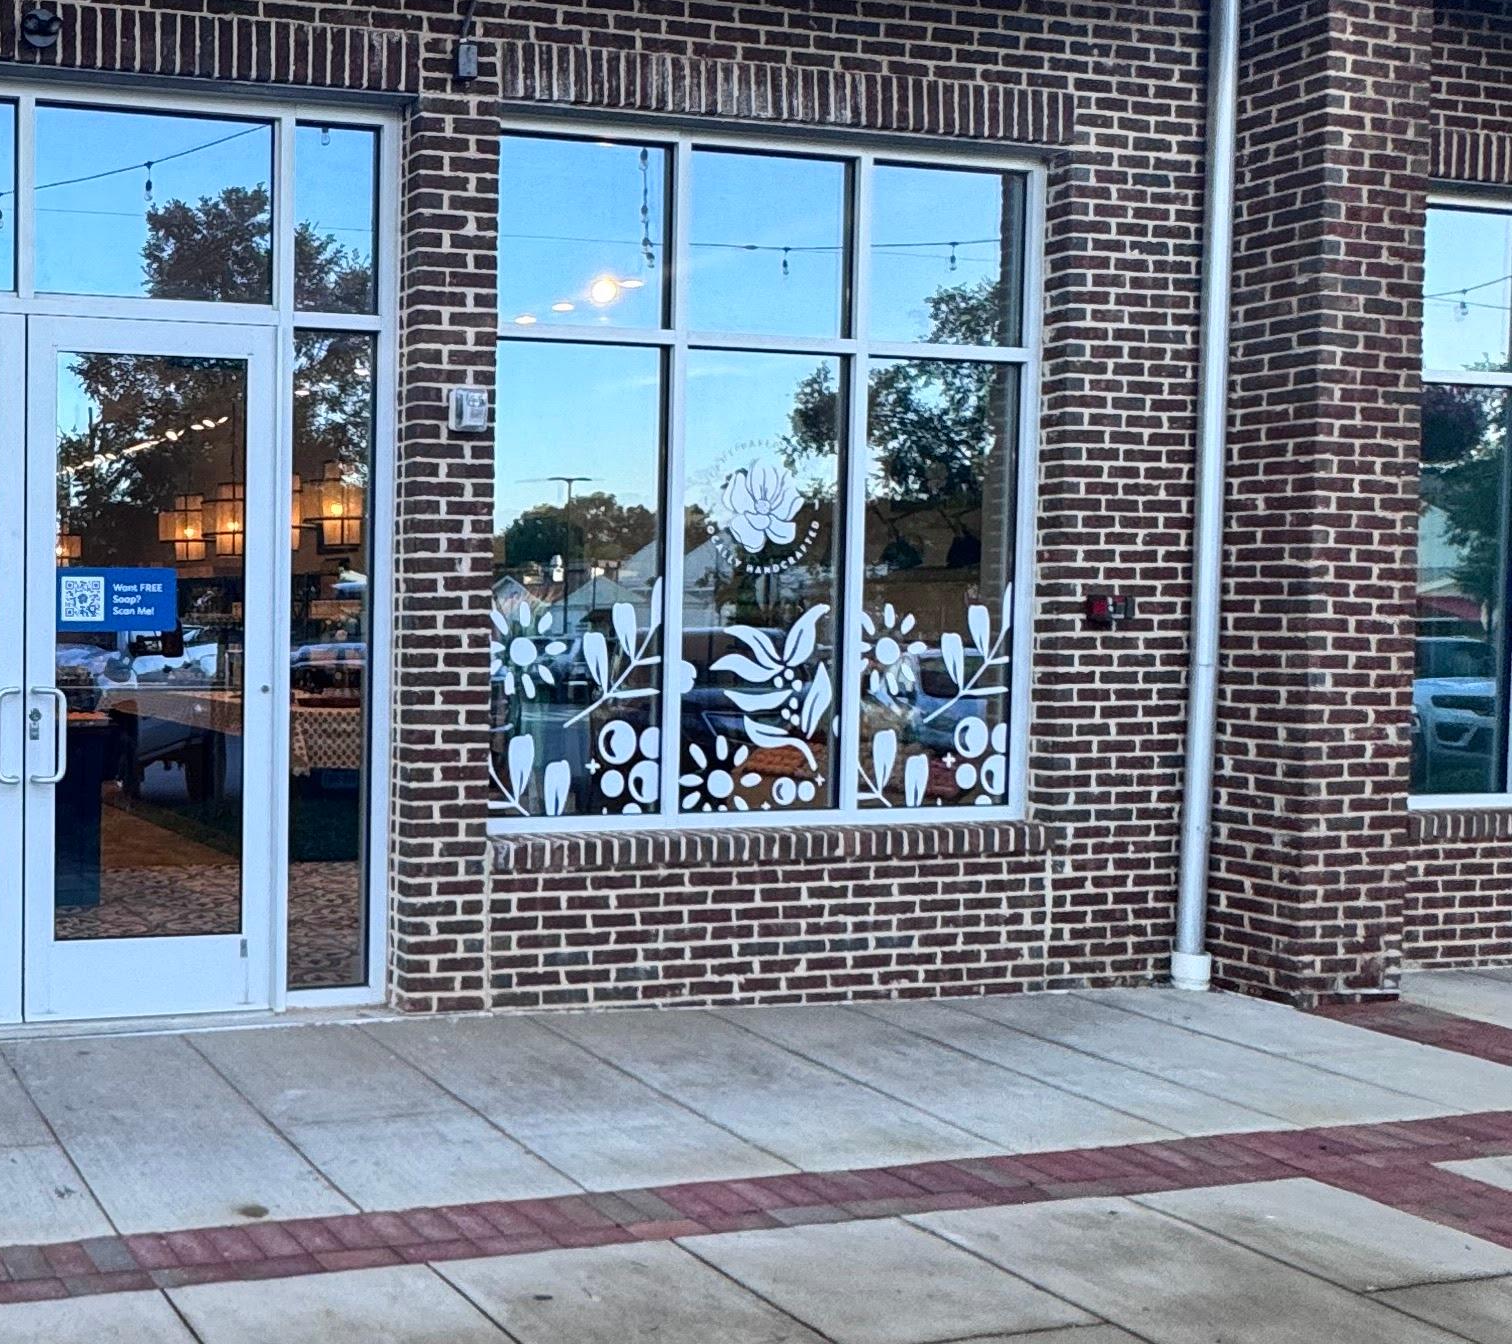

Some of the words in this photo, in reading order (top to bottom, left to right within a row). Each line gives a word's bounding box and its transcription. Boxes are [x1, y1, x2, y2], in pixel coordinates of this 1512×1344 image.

[745, 520, 820, 574] HANDCRAFTED
[113, 583, 138, 593] Want
[140, 583, 163, 593] FREE
[113, 594, 141, 606] Soap?
[113, 606, 136, 616] Scan
[137, 606, 155, 616] Me!
